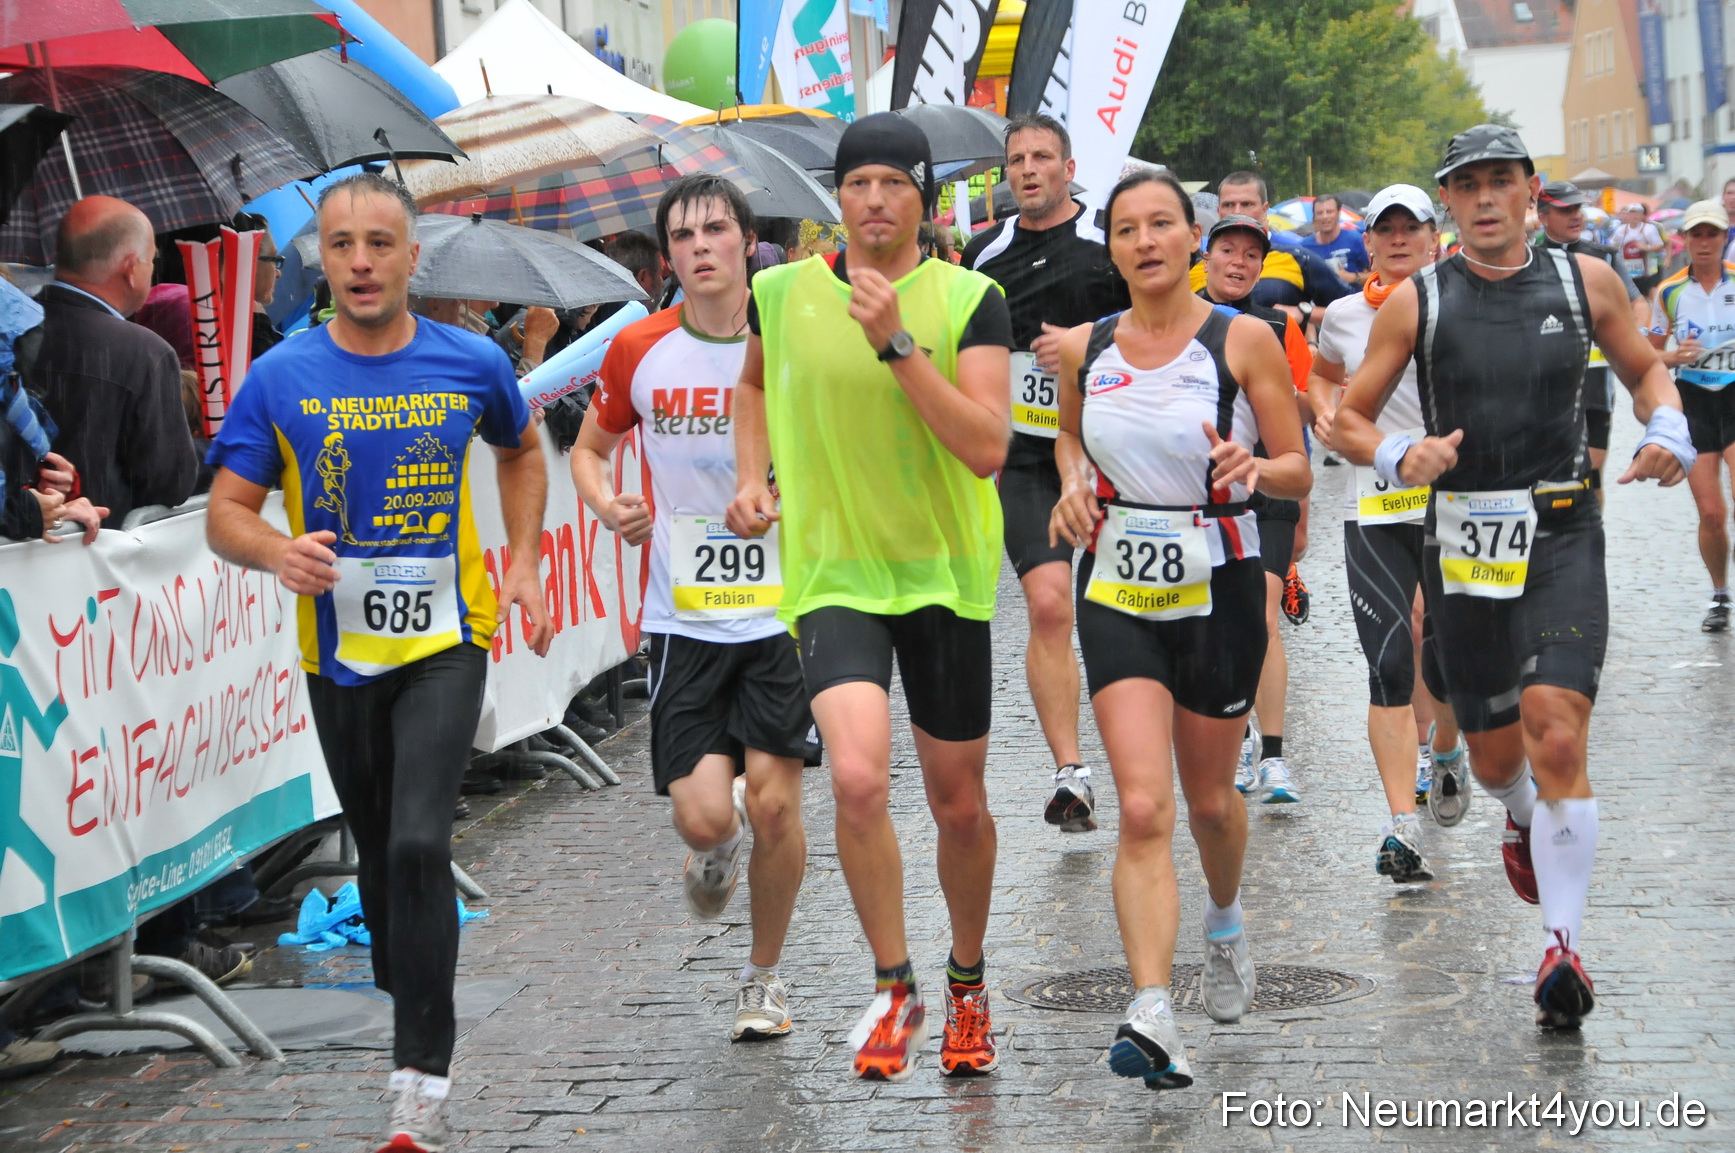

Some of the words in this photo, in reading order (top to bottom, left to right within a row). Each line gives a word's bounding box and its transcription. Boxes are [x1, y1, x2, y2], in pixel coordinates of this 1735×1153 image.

[1097, 36, 1139, 135] Audi
[192, 289, 230, 438] USTRIA
[1022, 374, 1059, 406] 35
[300, 398, 327, 415] 10.
[331, 393, 469, 414] NEUMARKTER
[328, 410, 447, 431] STADTLAUF
[652, 408, 730, 436] Reise
[384, 491, 454, 510] 20.09.2009
[1382, 493, 1428, 512] Evelyne
[1126, 516, 1170, 530] BOCK
[1460, 520, 1528, 558] 374
[374, 565, 427, 578] BOCK
[695, 544, 765, 582] 299
[1116, 539, 1185, 583] 328
[1470, 565, 1516, 583] Baldur
[705, 591, 755, 605] Fabian
[1116, 589, 1180, 608] Gabriele
[363, 589, 433, 634] 685
